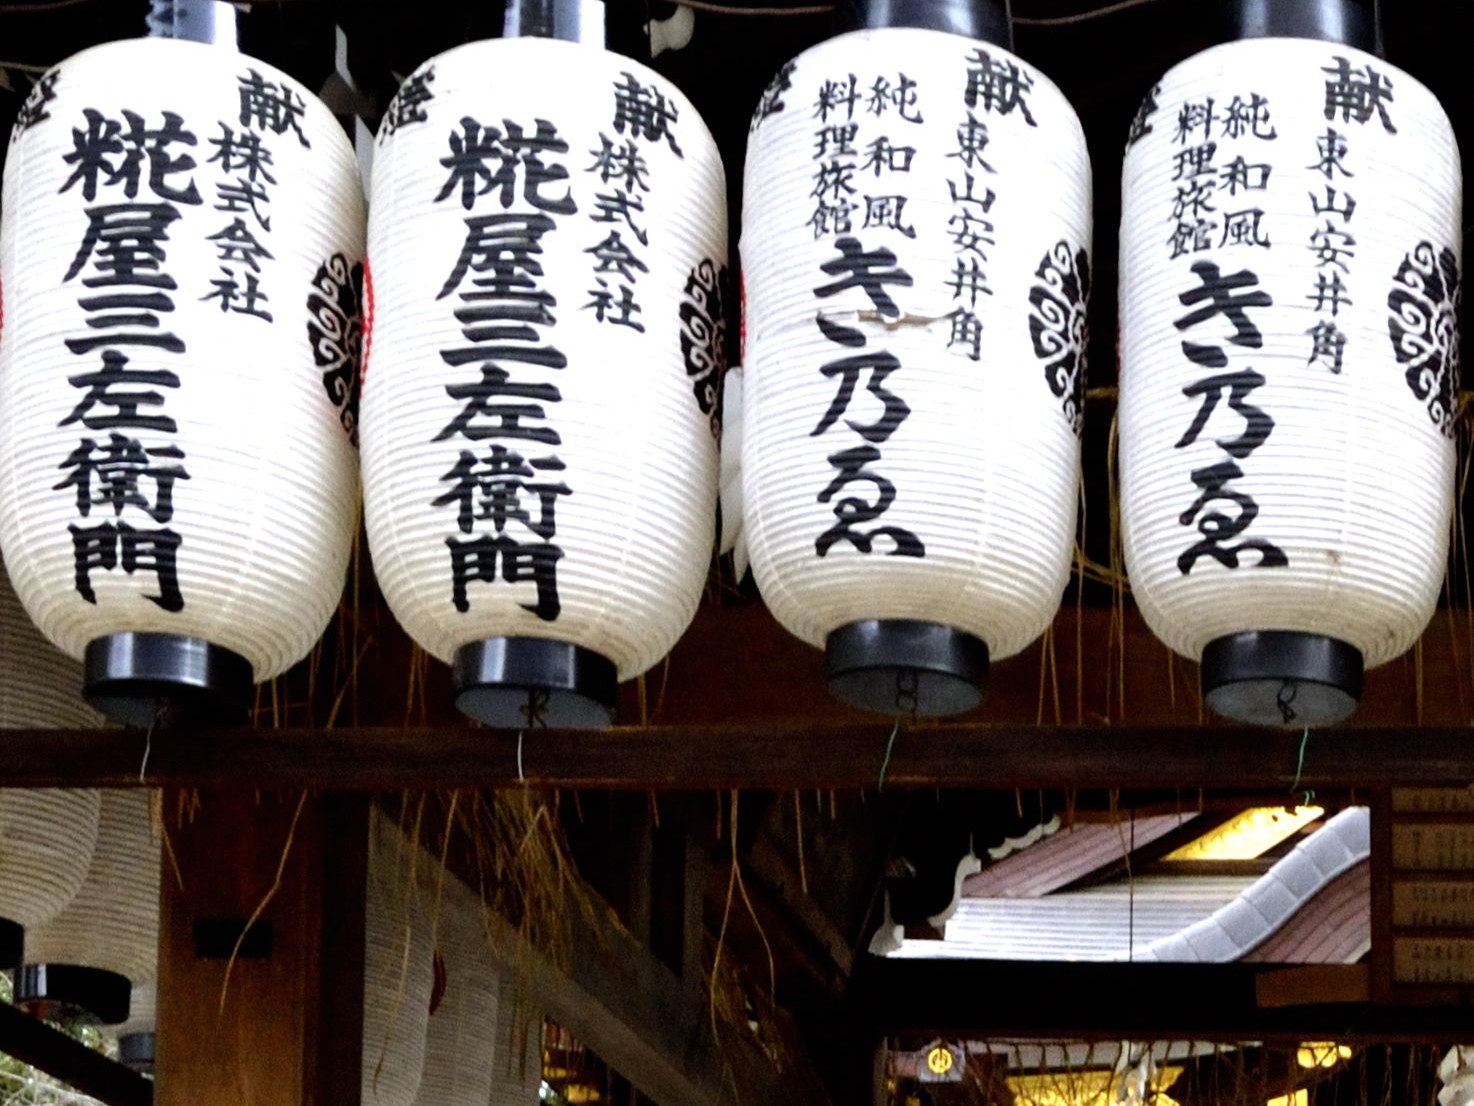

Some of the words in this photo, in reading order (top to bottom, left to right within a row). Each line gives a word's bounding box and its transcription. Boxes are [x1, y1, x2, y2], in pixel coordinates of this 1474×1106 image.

[238, 68, 311, 149] 献
[612, 70, 684, 158] 献
[804, 73, 861, 240] 料理旅館
[862, 73, 925, 239] 純和風
[964, 47, 1038, 127] 献
[1321, 55, 1397, 134] 献
[200, 121, 279, 323] 株式会社
[583, 132, 651, 333] 株式会社
[944, 114, 998, 362] 東山安井角
[1167, 97, 1220, 260] 料理旅館
[1219, 92, 1278, 251] 純和風
[1304, 128, 1357, 375] 東山安井角
[52, 108, 203, 614] 糀屋三左衛門
[432, 117, 578, 623] 糀屋三左衛門
